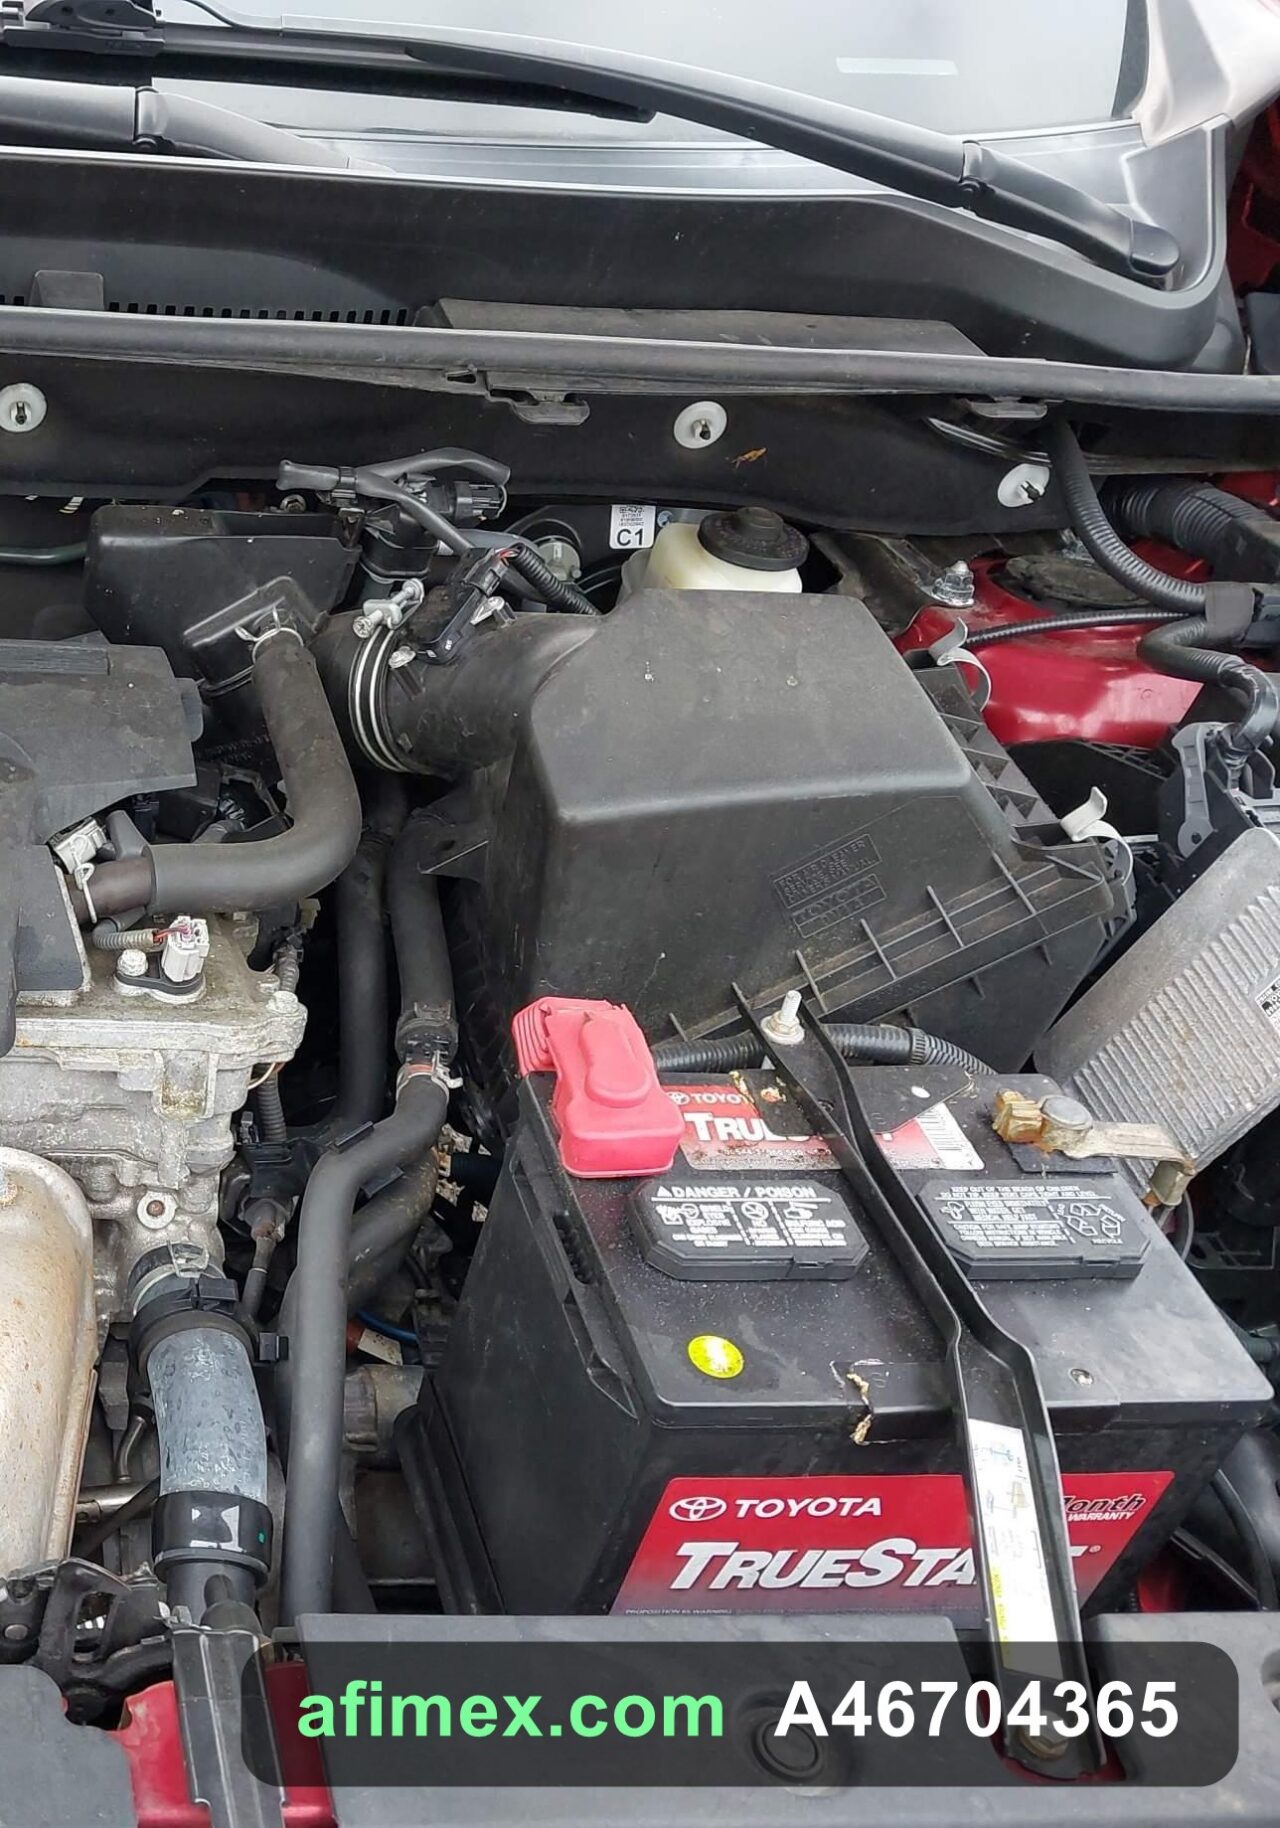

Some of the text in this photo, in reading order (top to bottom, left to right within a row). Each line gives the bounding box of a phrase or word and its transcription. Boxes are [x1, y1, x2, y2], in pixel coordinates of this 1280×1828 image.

[617, 525, 645, 547] C1
[671, 1186, 741, 1198] DANGER
[754, 1186, 817, 1198] POISON
[734, 1497, 882, 1519] TOYOTA
[1067, 1511, 1135, 1522] WARRANTY
